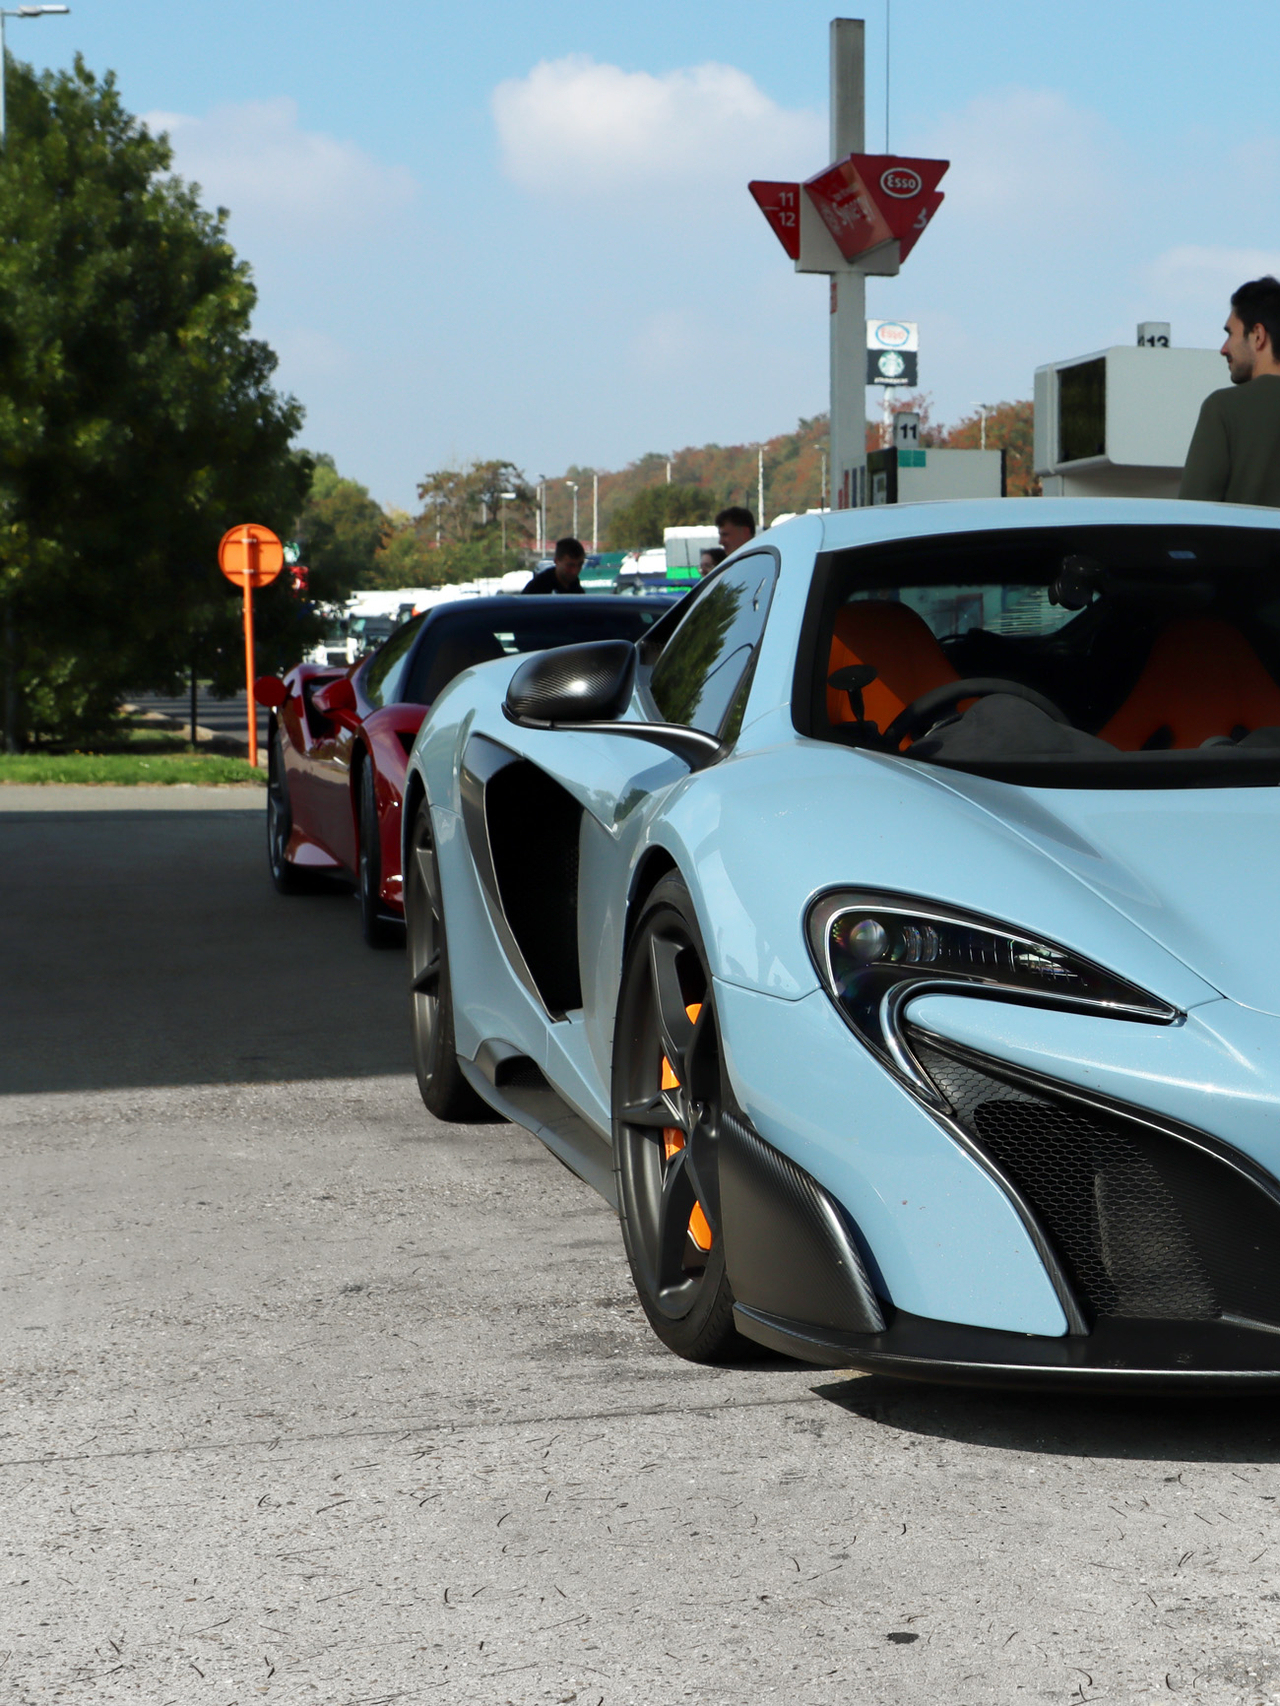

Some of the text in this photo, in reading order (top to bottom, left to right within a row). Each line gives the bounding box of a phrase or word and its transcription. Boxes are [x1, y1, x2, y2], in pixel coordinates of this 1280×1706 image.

[886, 174, 917, 189] Esso
[778, 191, 795, 207] 11
[778, 211, 796, 227] 12
[900, 423, 917, 440] 11
